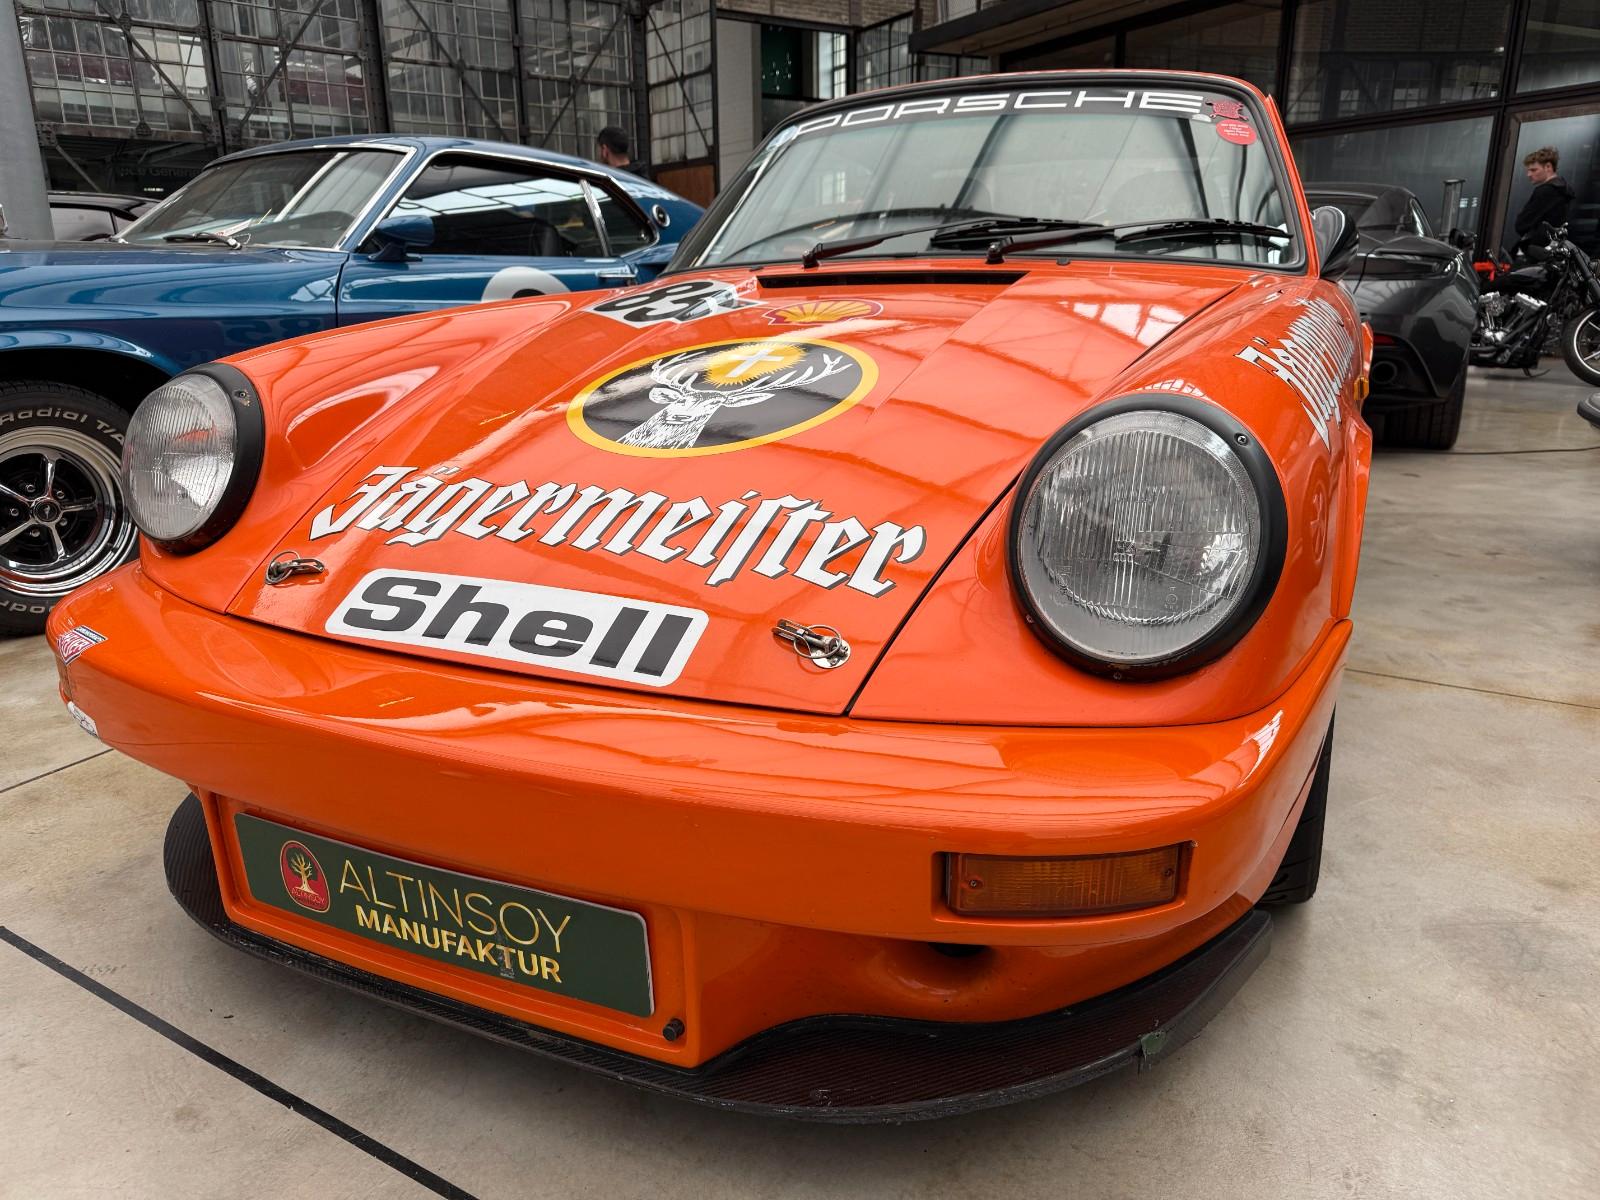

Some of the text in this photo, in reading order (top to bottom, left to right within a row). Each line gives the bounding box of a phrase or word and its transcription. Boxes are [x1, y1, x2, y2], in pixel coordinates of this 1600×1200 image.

[791, 90, 1203, 141] PORSCHE
[342, 575, 695, 677] Shell
[339, 859, 571, 953] ALTINSOY
[355, 904, 562, 984] MANUFAKTUR
